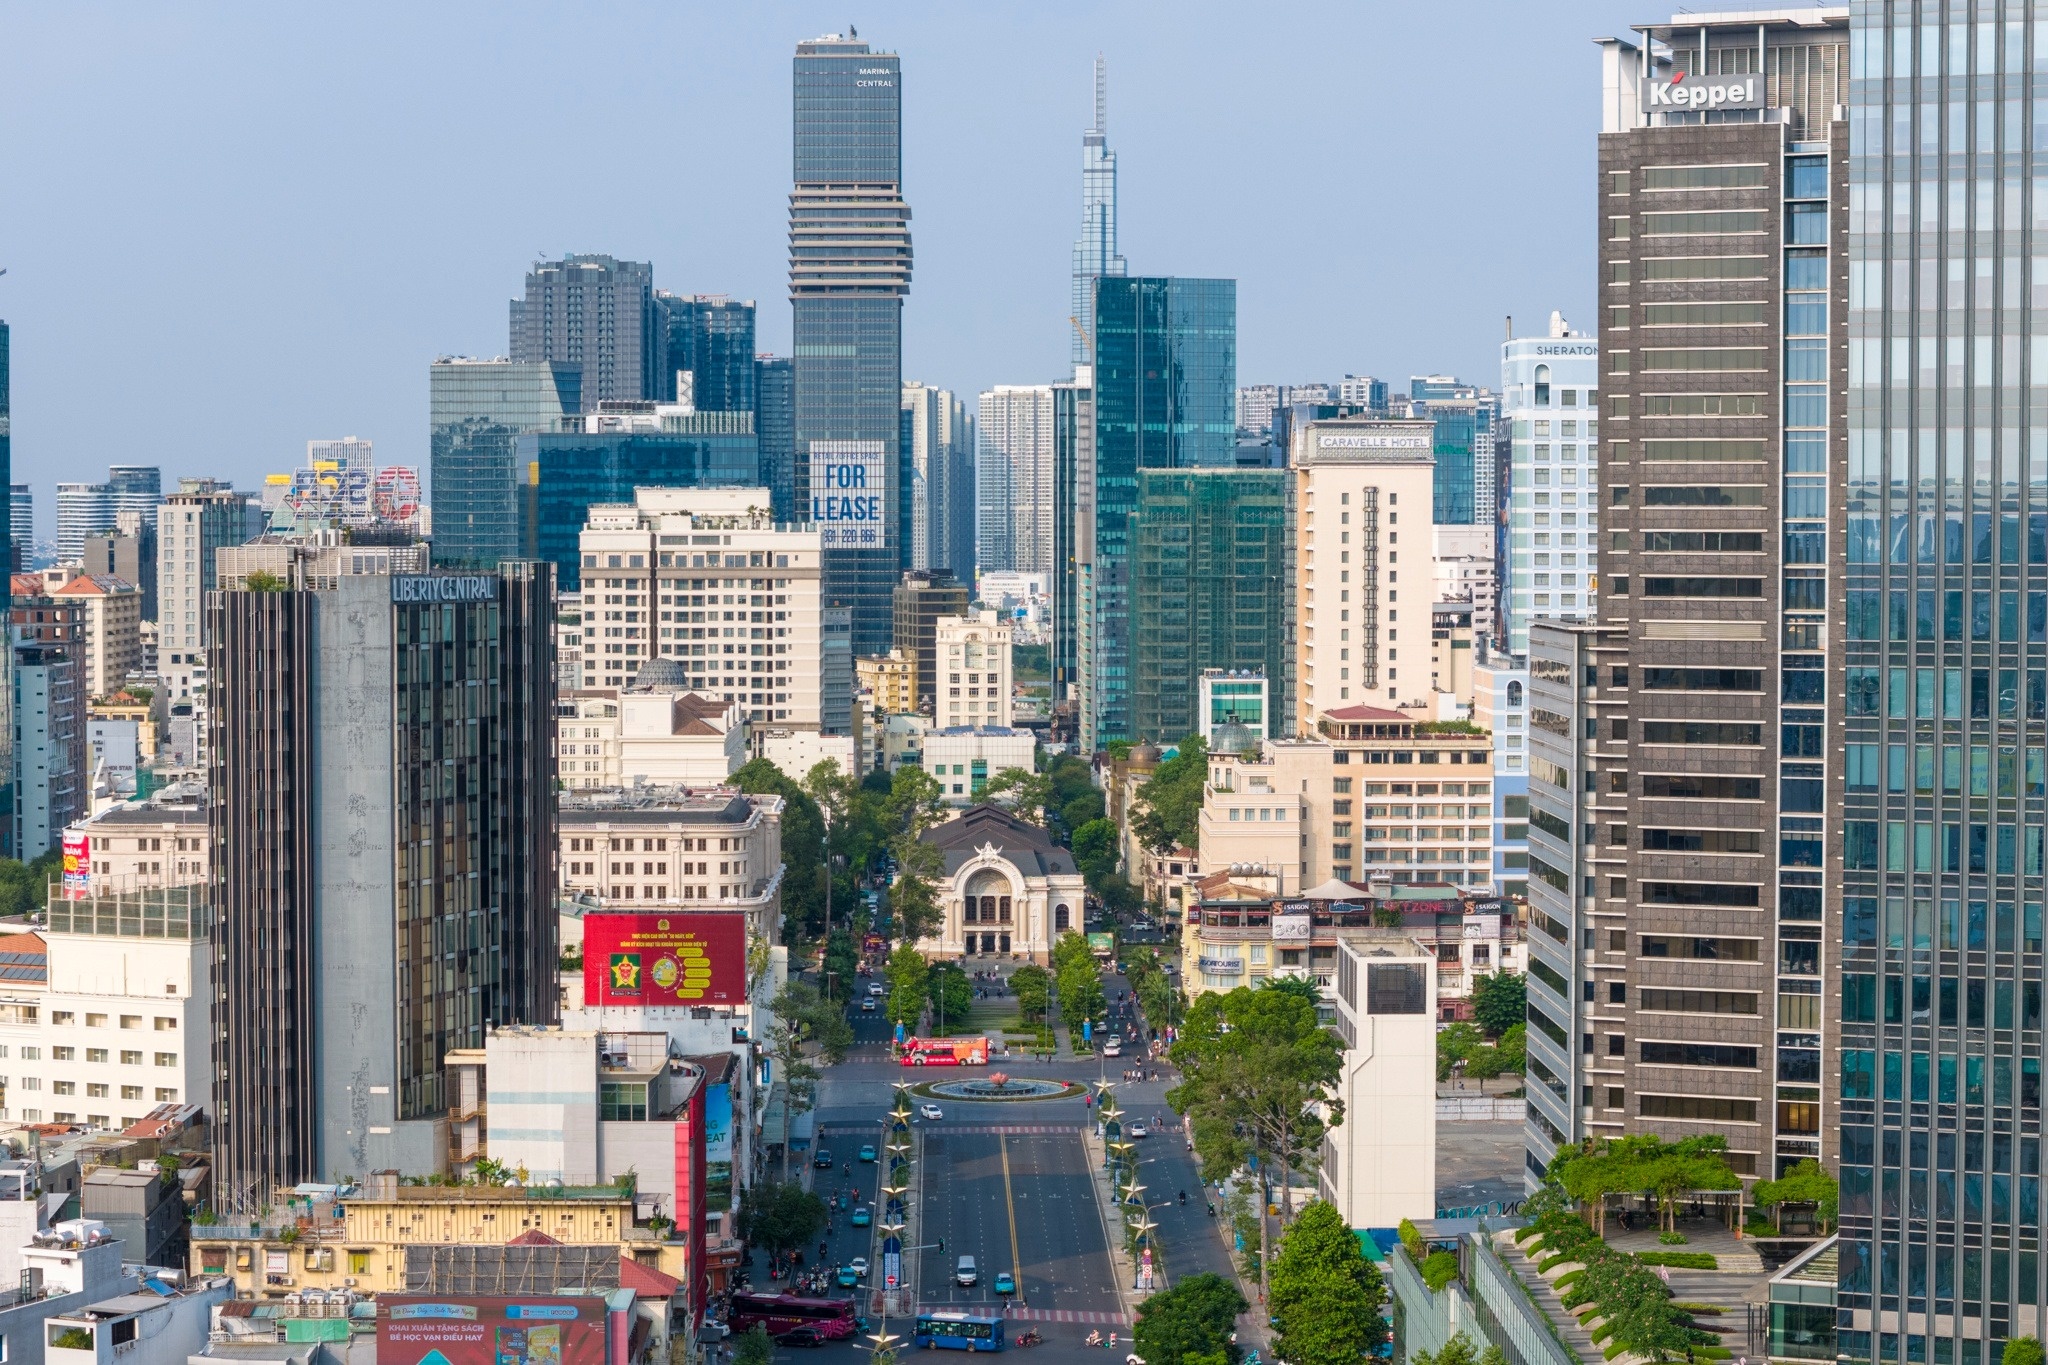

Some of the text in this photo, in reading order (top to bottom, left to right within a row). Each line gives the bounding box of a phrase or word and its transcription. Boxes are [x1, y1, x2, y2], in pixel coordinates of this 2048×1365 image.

[1650, 75, 1754, 109] Keppel
[1324, 438, 1427, 447] CARAVELLE HOTEL
[825, 463, 865, 488] FOR
[813, 496, 880, 521] LEASE
[1411, 901, 1445, 912] ZONE
[411, 1323, 435, 1332] XUÂN
[461, 1323, 484, 1332] SÁCH
[403, 1334, 421, 1342] HỌC
